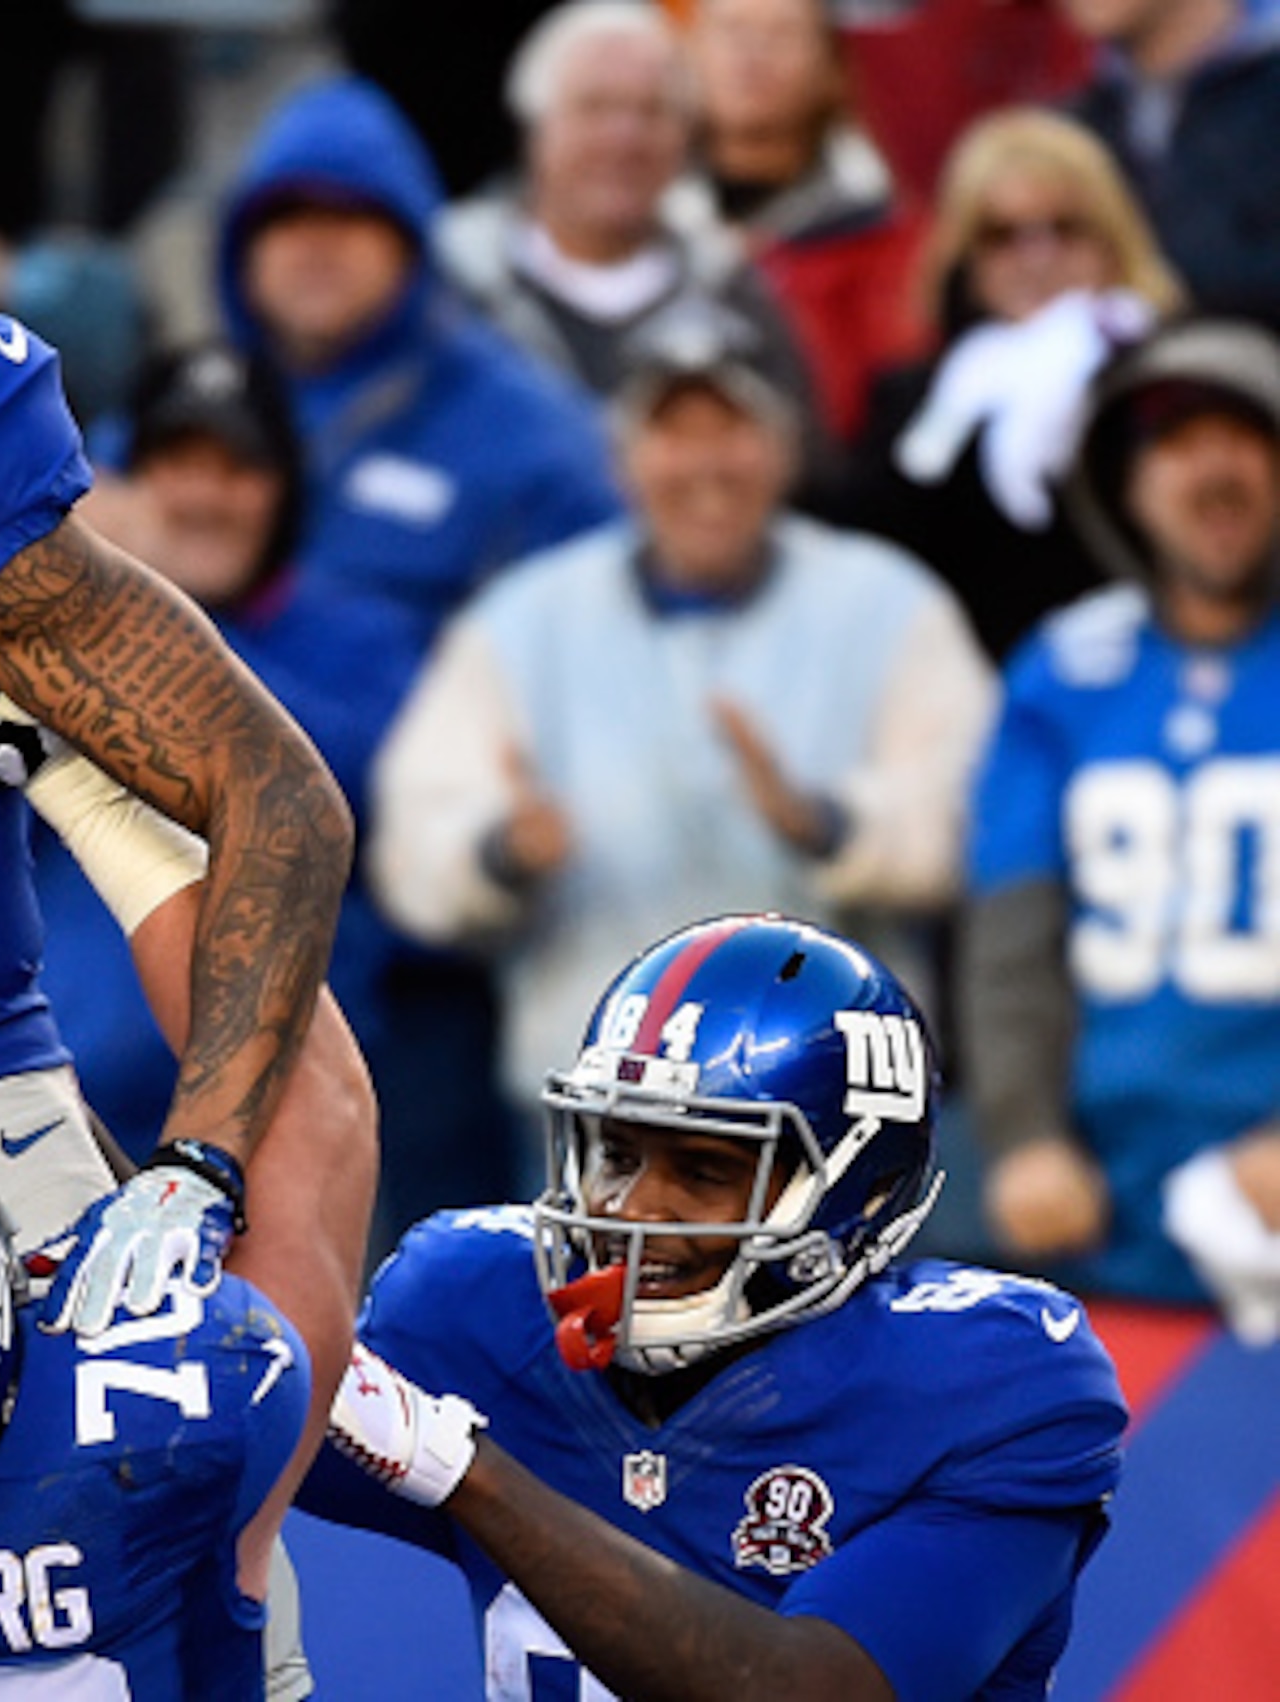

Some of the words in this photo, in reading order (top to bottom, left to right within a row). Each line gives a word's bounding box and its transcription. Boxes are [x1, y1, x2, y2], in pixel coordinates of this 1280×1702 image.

[1063, 757, 1280, 1002] 90
[599, 994, 704, 1062] 84
[765, 1476, 813, 1523] 90
